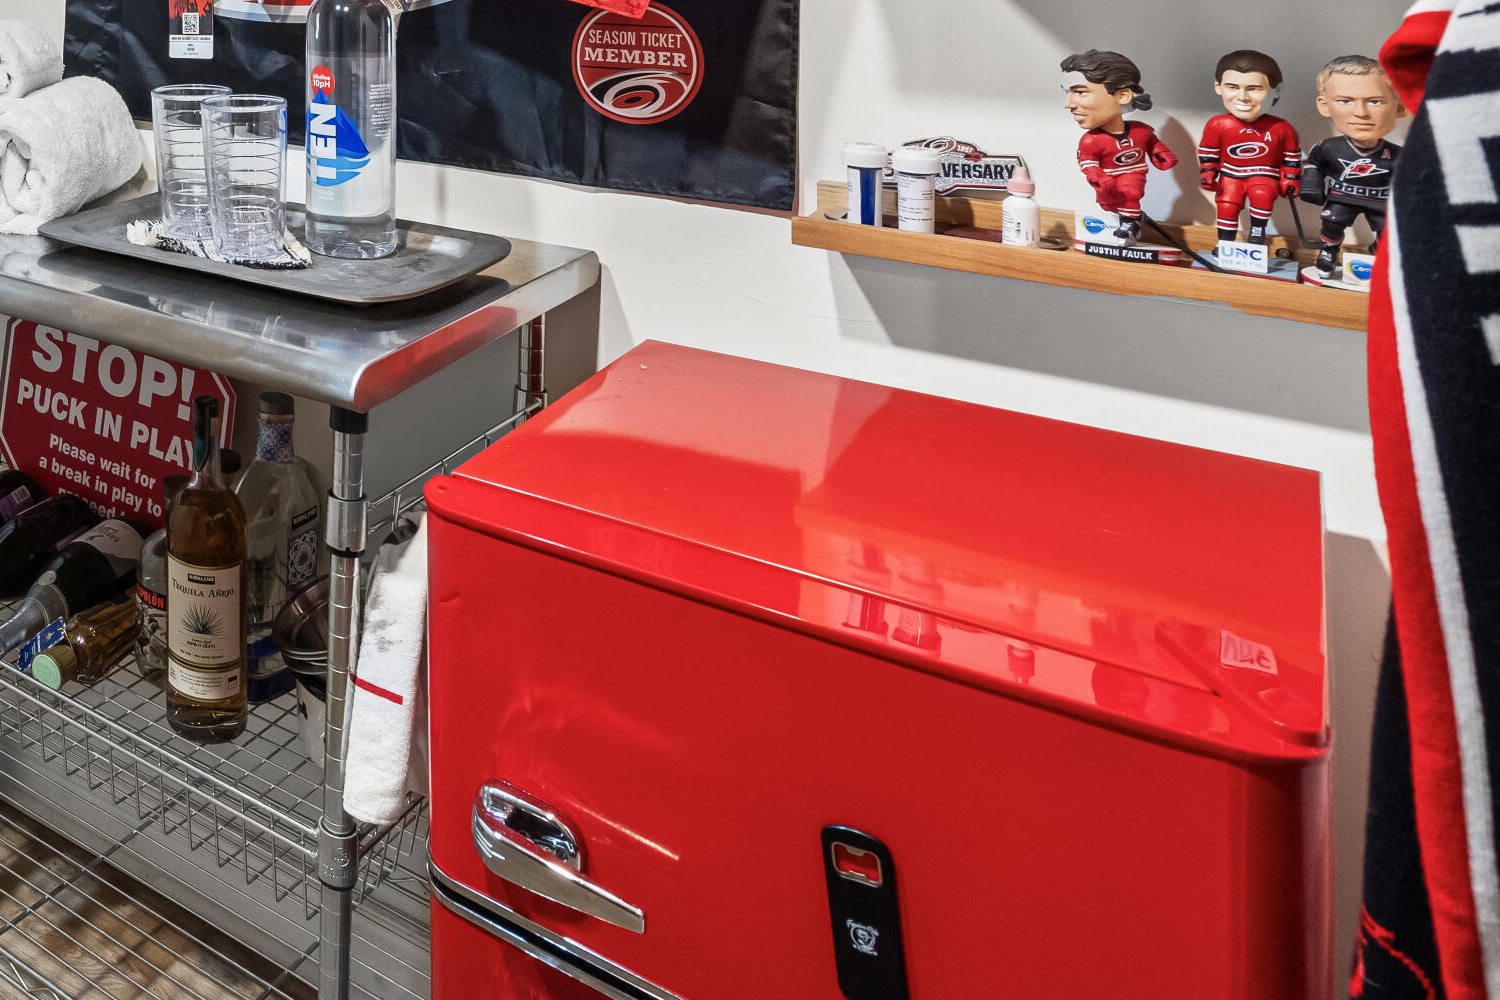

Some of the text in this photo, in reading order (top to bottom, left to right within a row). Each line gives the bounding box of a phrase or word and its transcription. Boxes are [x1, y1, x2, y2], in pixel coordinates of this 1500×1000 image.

[588, 29, 683, 49] SEASON TICKET
[583, 47, 688, 68] MEMBER
[313, 79, 331, 89] 10pH
[310, 103, 337, 183] TEN
[1263, 131, 1273, 142] A
[1381, 148, 1391, 159] A
[940, 162, 1015, 180] VERSARY
[1088, 245, 1153, 260] JUSTIN FAULK
[1220, 246, 1263, 261] UNC
[1221, 258, 1264, 269] HEALTH
[31, 323, 195, 422] STOP!
[17, 378, 89, 430] PUCK
[94, 407, 123, 443] IN
[49, 433, 157, 490] Please wait for
[39, 456, 163, 518] a break in play to
[171, 577, 235, 599] TEQUILA AÑEJO
